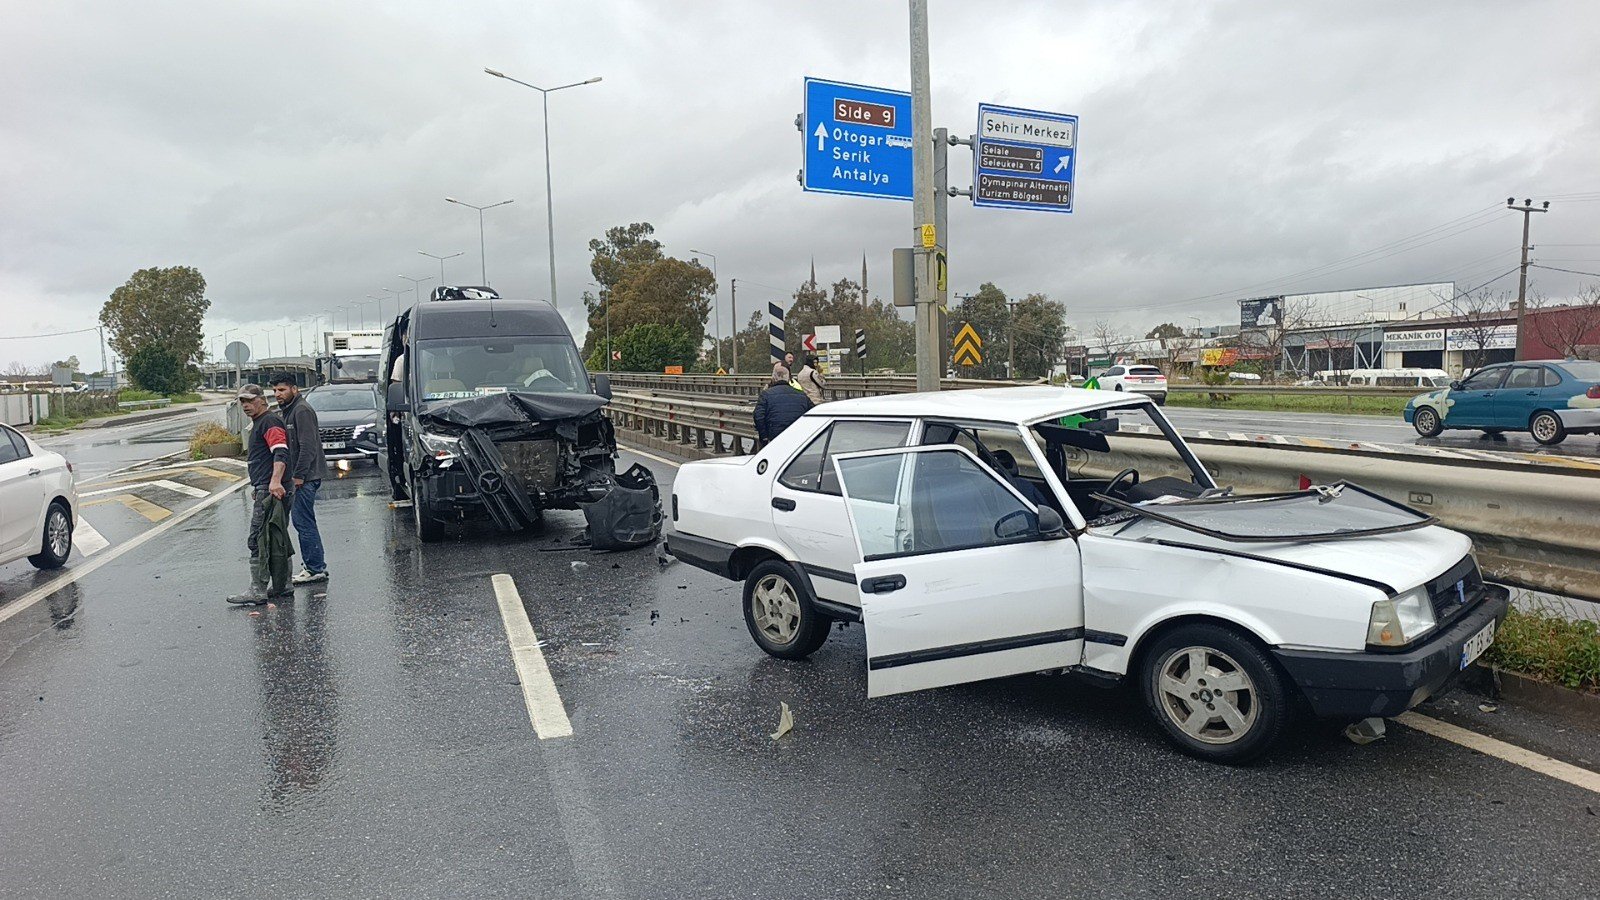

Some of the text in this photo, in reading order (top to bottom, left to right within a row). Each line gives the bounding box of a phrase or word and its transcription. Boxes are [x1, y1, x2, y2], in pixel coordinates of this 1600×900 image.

[838, 103, 891, 123] Side 9
[833, 127, 883, 147] Otogar
[986, 119, 1070, 140] Şehir Merkezi
[832, 146, 871, 163] Serik
[1035, 150, 1041, 158] 8
[1029, 162, 1040, 170] 14
[832, 165, 889, 186] Antalya
[1029, 181, 1069, 192] Alternatif
[980, 188, 1010, 198] Turizm
[1012, 190, 1042, 202] Bölgesi
[1386, 332, 1423, 340] MEKANİK
[1424, 331, 1442, 339] OTO
